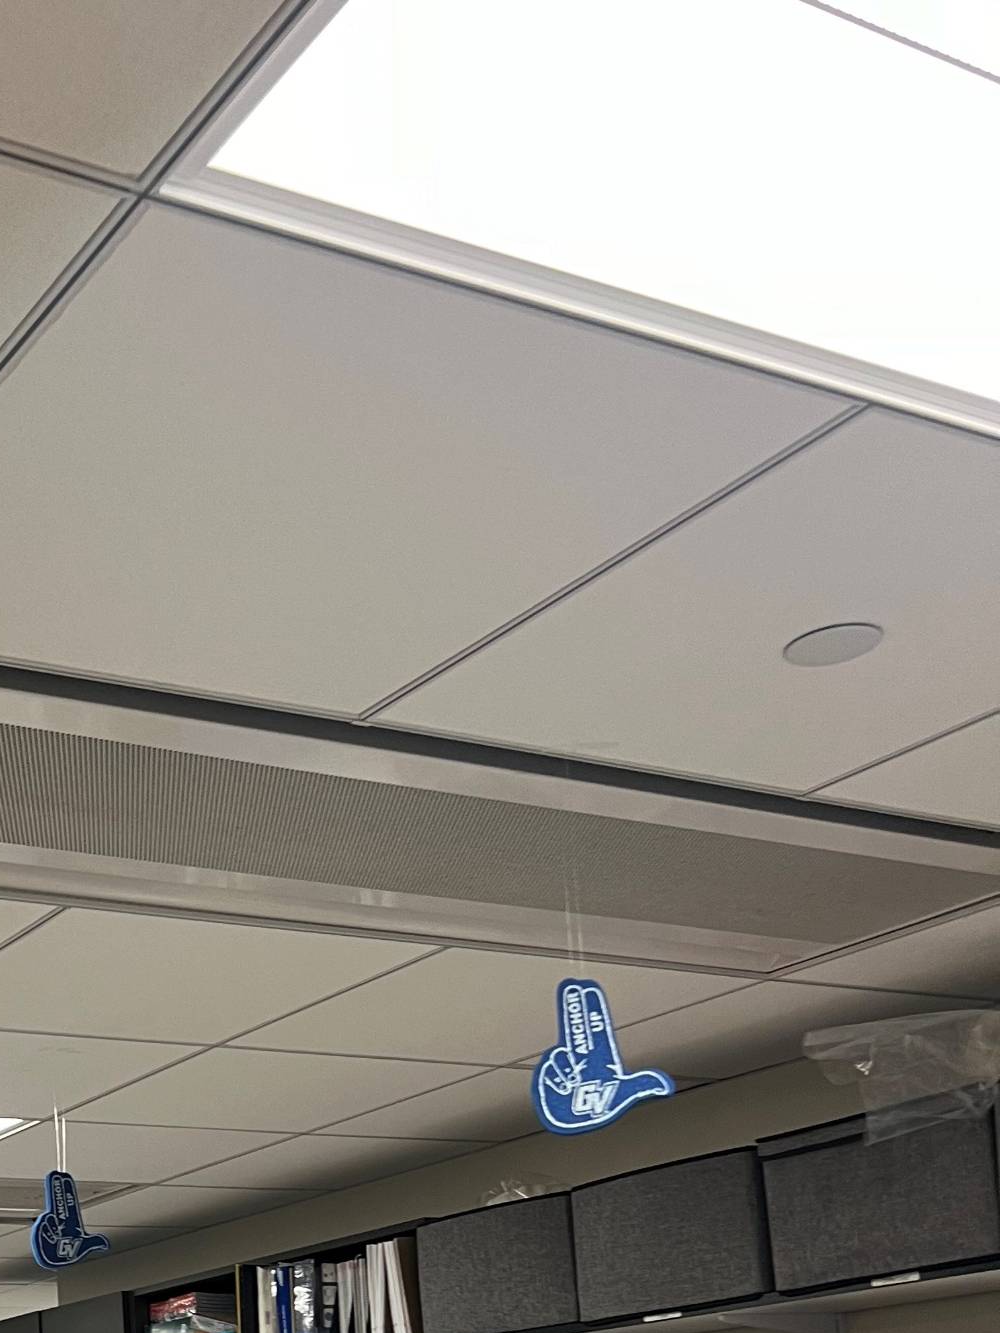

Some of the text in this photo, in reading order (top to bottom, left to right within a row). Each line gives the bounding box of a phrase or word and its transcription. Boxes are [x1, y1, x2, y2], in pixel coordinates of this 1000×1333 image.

[567, 991, 588, 1054] ANCHOR
[591, 1011, 604, 1032] UP
[571, 1079, 620, 1118] GV
[53, 1179, 67, 1220] ANCHOR
[66, 1193, 74, 1206] UP
[57, 1236, 83, 1260] GV
